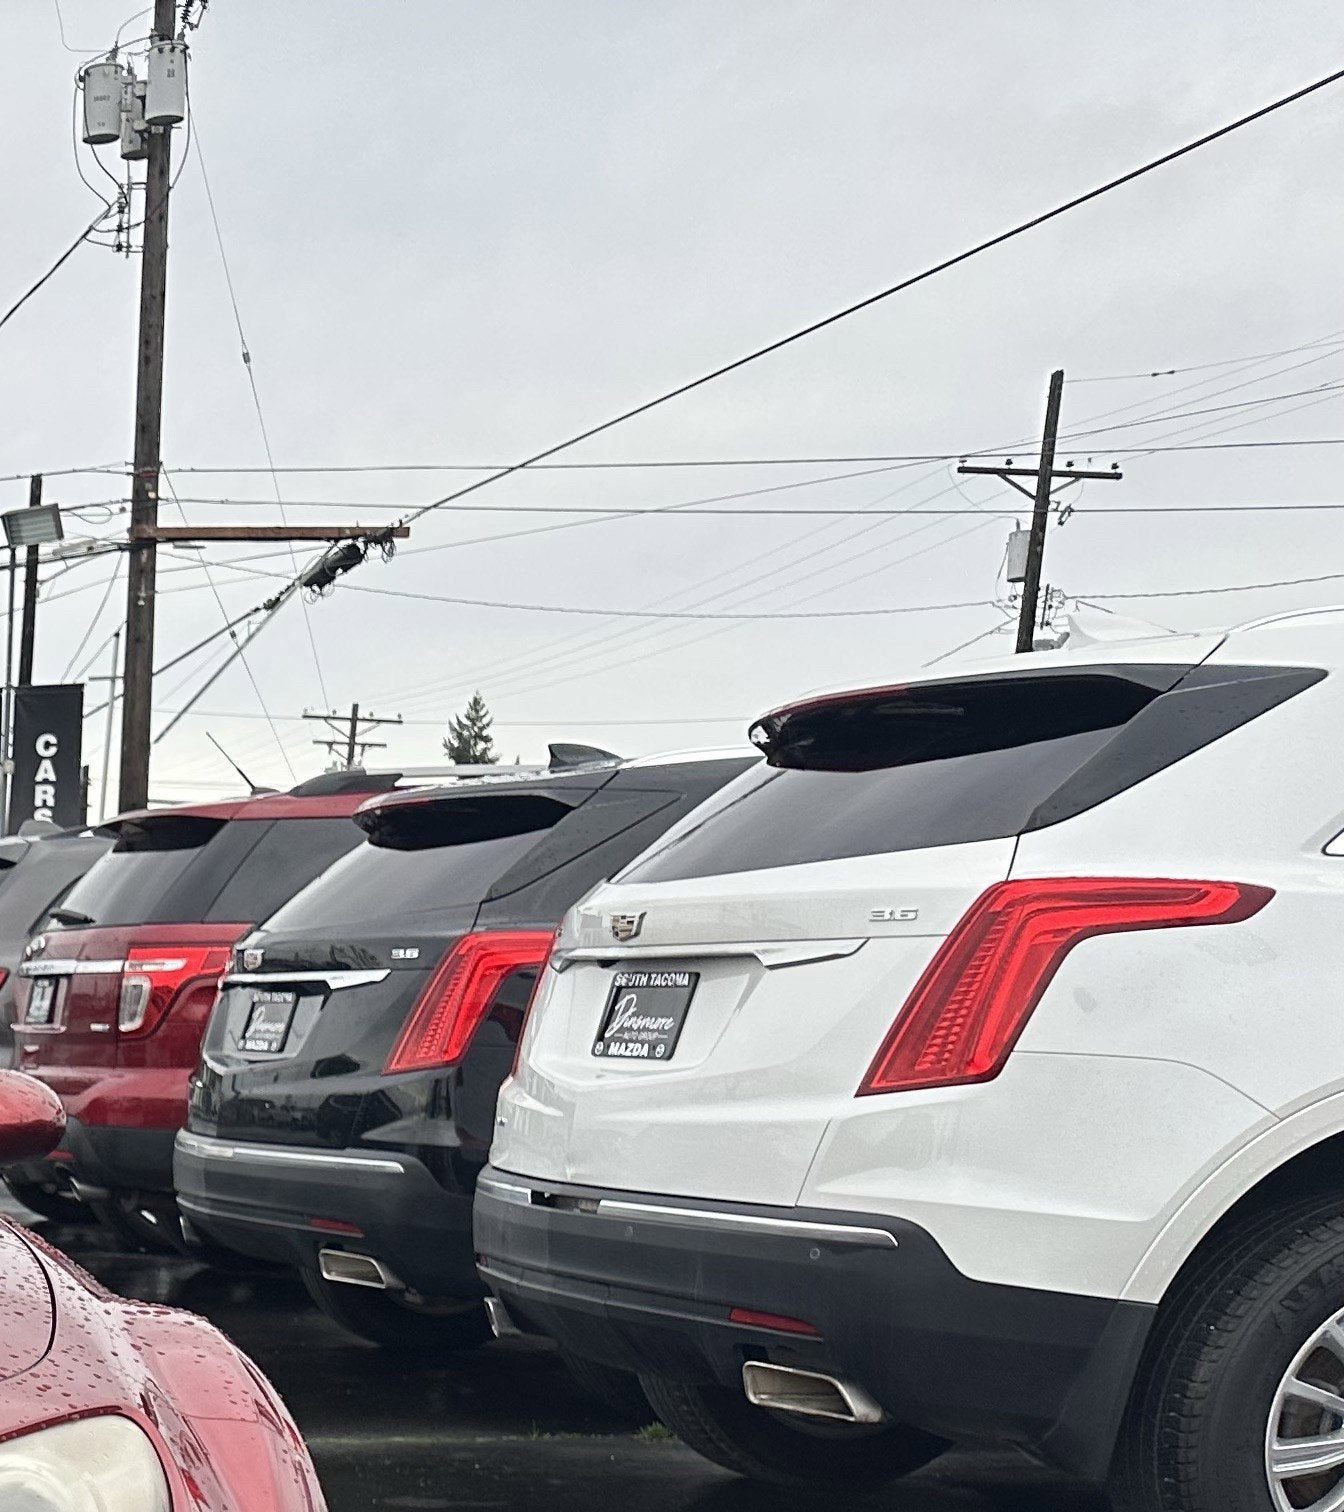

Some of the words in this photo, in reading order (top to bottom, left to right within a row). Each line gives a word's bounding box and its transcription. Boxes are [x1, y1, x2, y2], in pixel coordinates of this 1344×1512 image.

[33, 733, 58, 823] CARS
[614, 973, 649, 987] SOUTH
[650, 973, 689, 987] TACOMA
[604, 994, 675, 1038] Dinsmore
[607, 1042, 649, 1057] MAZDA
